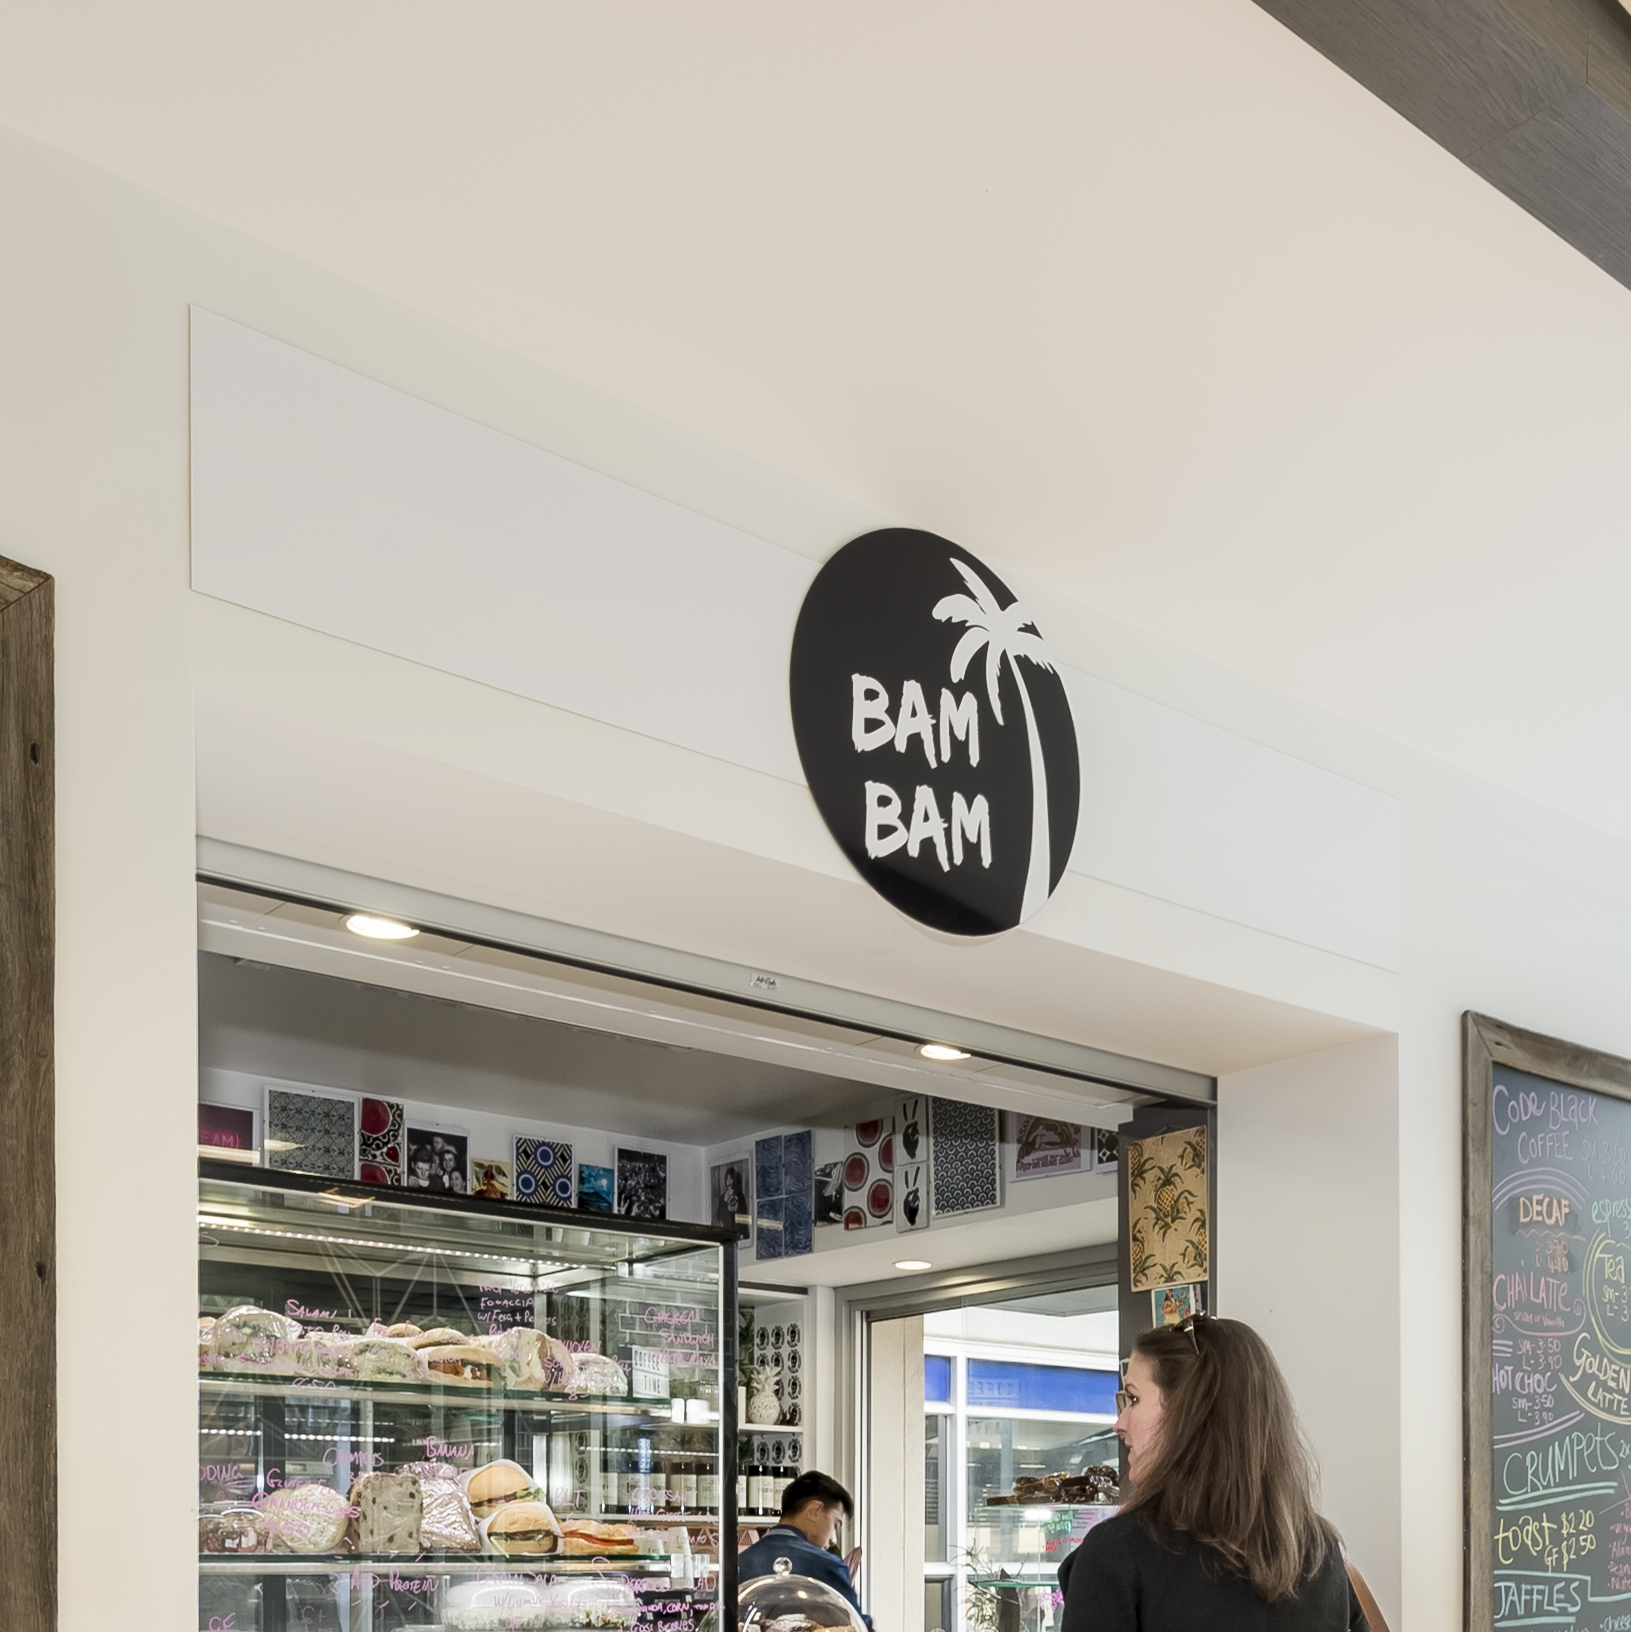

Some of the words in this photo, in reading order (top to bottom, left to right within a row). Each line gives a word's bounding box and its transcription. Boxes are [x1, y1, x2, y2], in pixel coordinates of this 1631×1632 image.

[851, 673, 980, 769] BAM
[864, 780, 993, 873] BAM
[1517, 1131, 1574, 1165] COFFEE
[1519, 1193, 1571, 1227] DECAF
[1492, 1362, 1514, 1395] HOT
[1514, 1371, 1558, 1395] CHOC
[1569, 1333, 1631, 1394] GOLDEN
[1587, 1380, 1631, 1416] LATTE
[1494, 1511, 1558, 1565] toast
[1493, 1581, 1582, 1619] JAFFLES
